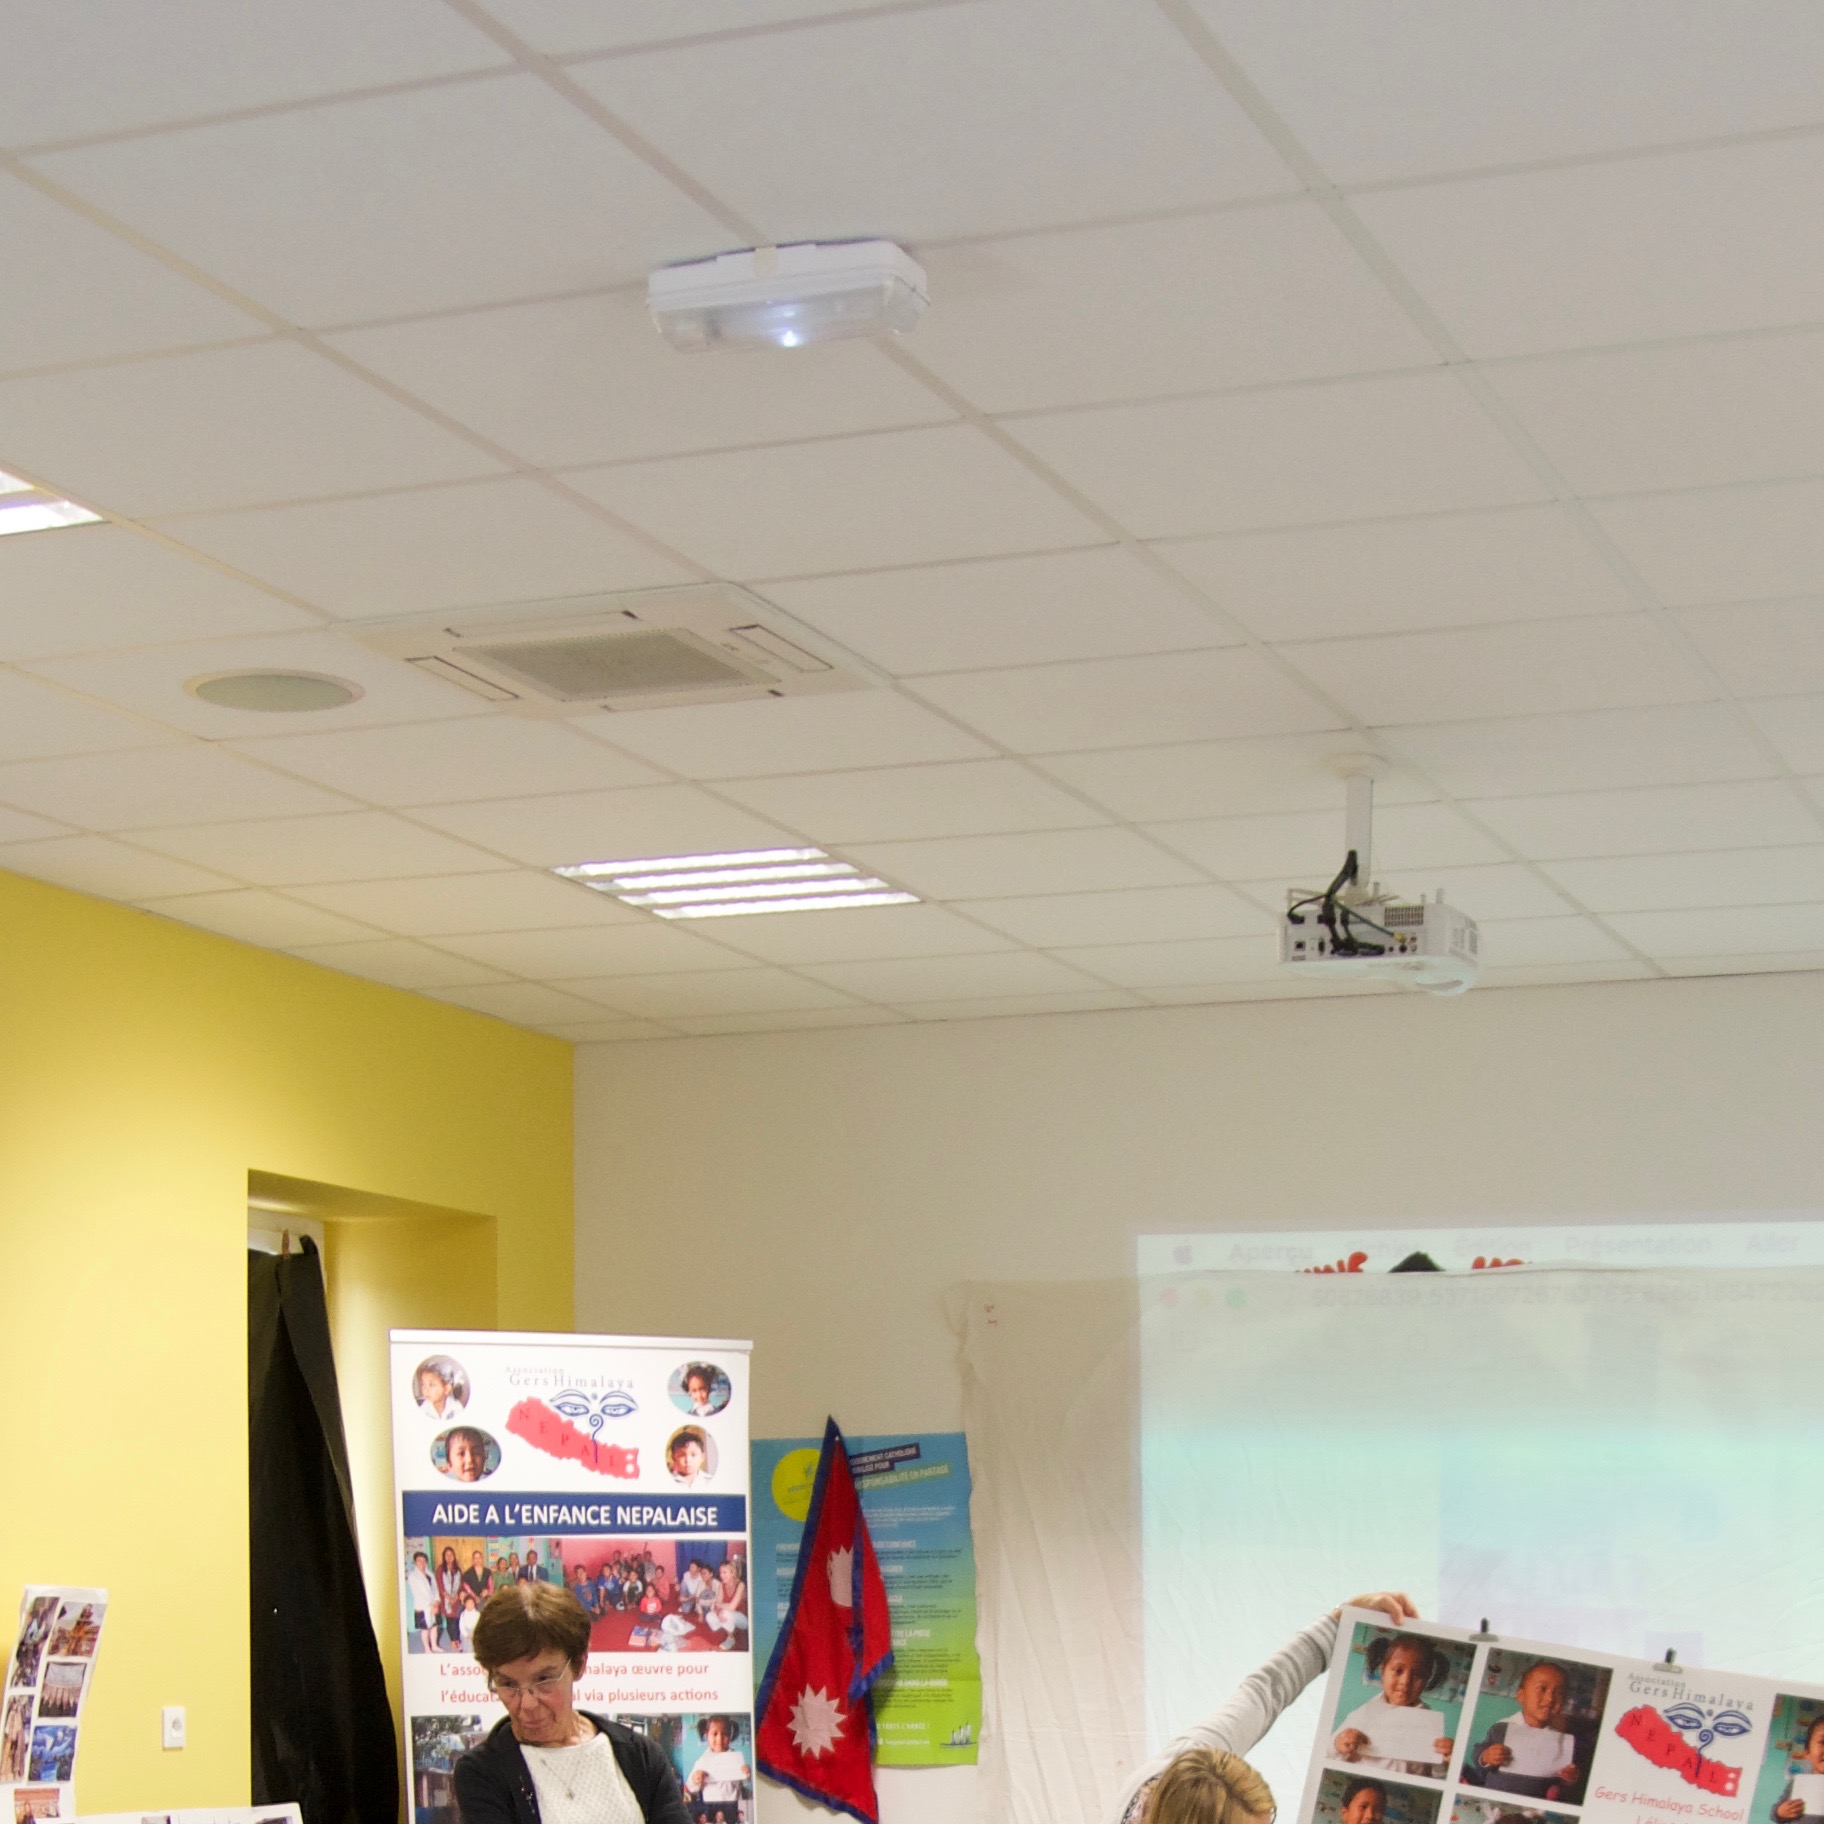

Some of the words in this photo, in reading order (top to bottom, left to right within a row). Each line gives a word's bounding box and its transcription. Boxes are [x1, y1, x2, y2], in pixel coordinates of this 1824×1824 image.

[509, 1373, 550, 1387] Gers
[553, 1374, 635, 1391] Himalaya
[432, 1504, 480, 1524] AIDE
[484, 1504, 500, 1524] A
[504, 1504, 611, 1526] L'ENFANCE
[616, 1506, 718, 1526] NEPALAISE
[677, 1665, 710, 1679] pour
[584, 1690, 606, 1702] via
[608, 1689, 667, 1704] plusieurs
[670, 1689, 720, 1702] actions
[1629, 1680, 1669, 1698] Gers
[1672, 1686, 1755, 1711] Himalaya
[1594, 1785, 1629, 1804] Gers
[1631, 1790, 1694, 1815] Himalaya
[1696, 1802, 1745, 1822] School
